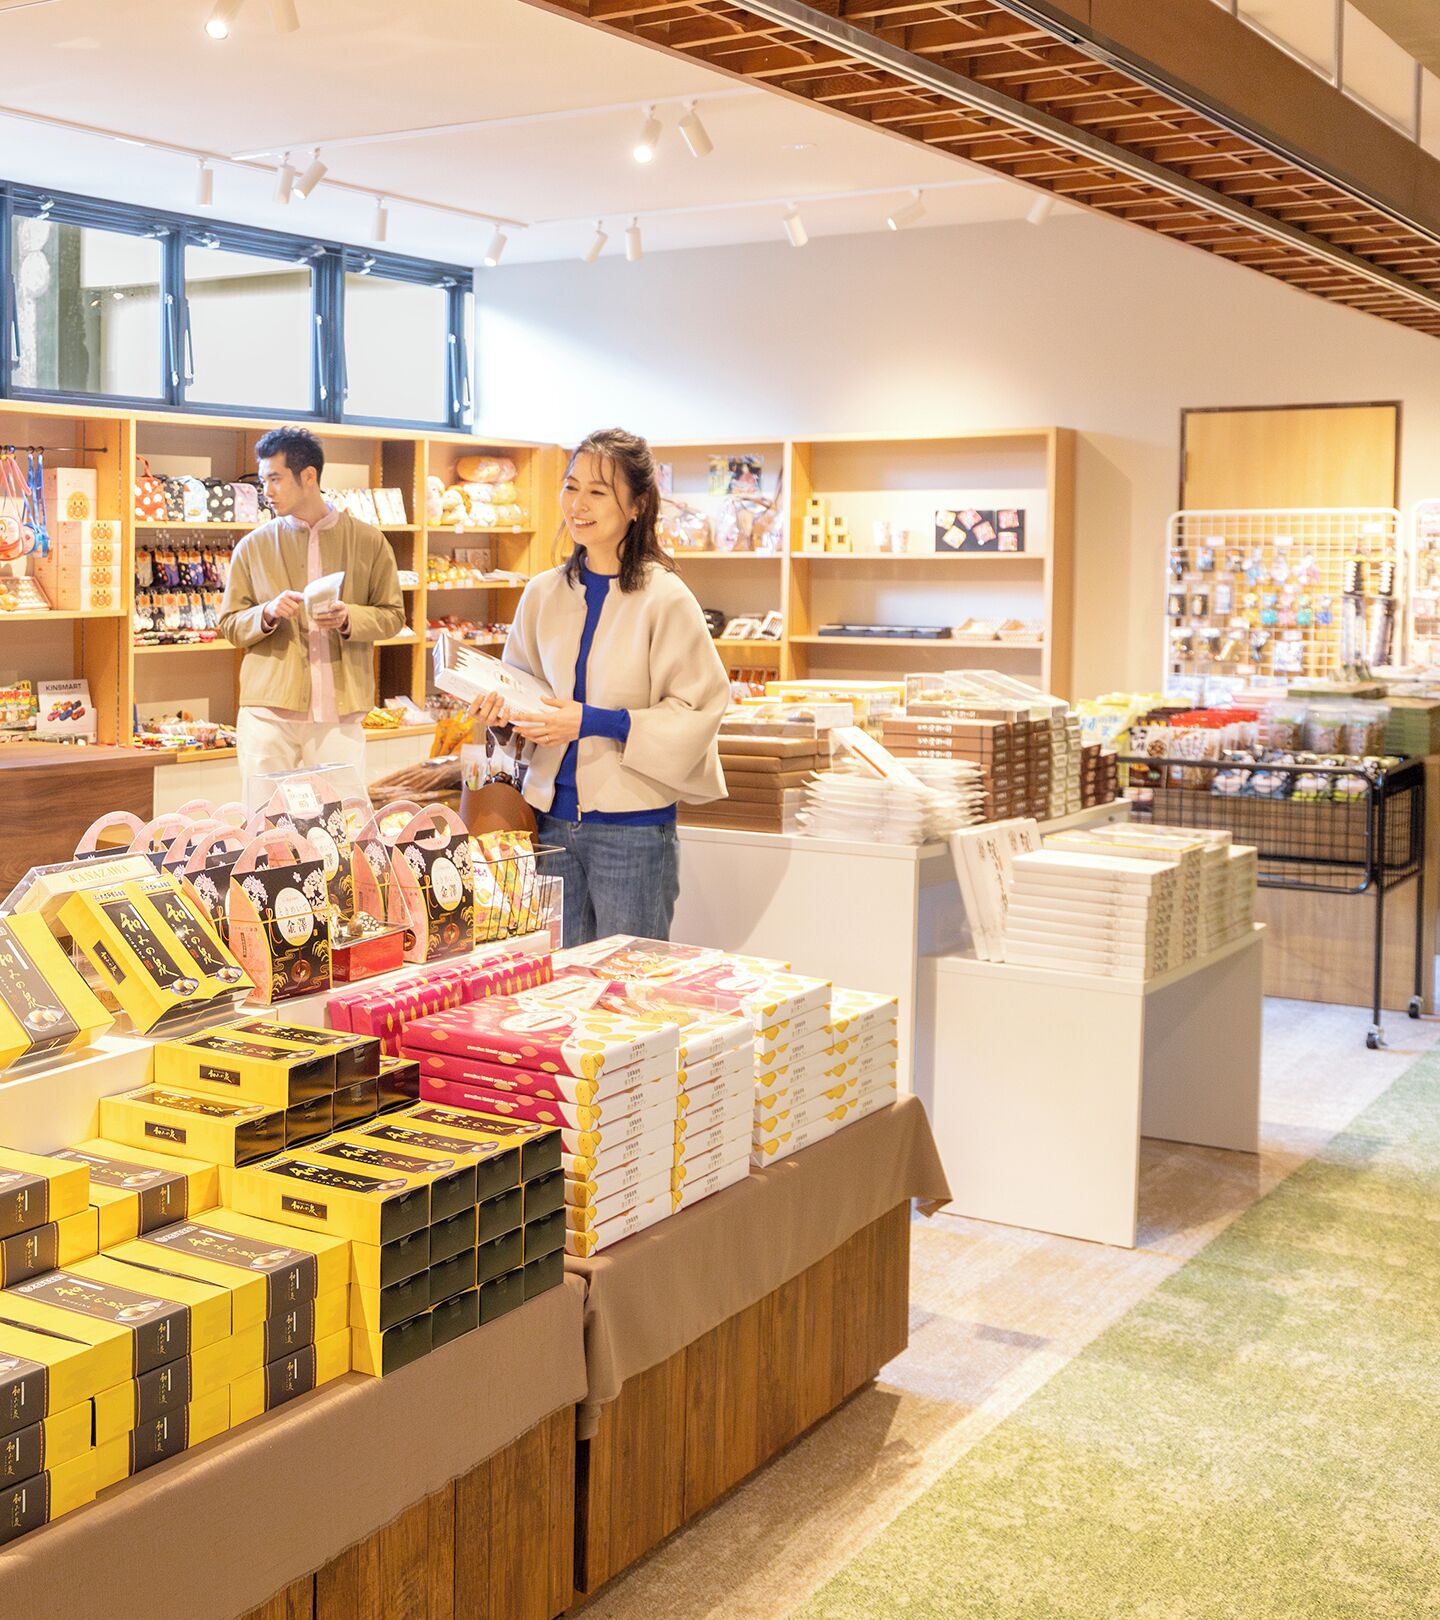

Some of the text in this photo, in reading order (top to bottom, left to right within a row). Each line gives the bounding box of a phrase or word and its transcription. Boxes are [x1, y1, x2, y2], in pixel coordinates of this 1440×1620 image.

[45, 683, 82, 692] KINSMART
[67, 864, 130, 885] KANAZAWA
[165, 902, 225, 965] 和みの泉
[287, 917, 308, 934] 金澤
[119, 912, 180, 977] 和みの泉
[289, 1165, 373, 1188] 和みの泉
[290, 1201, 318, 1218] 和みの泉
